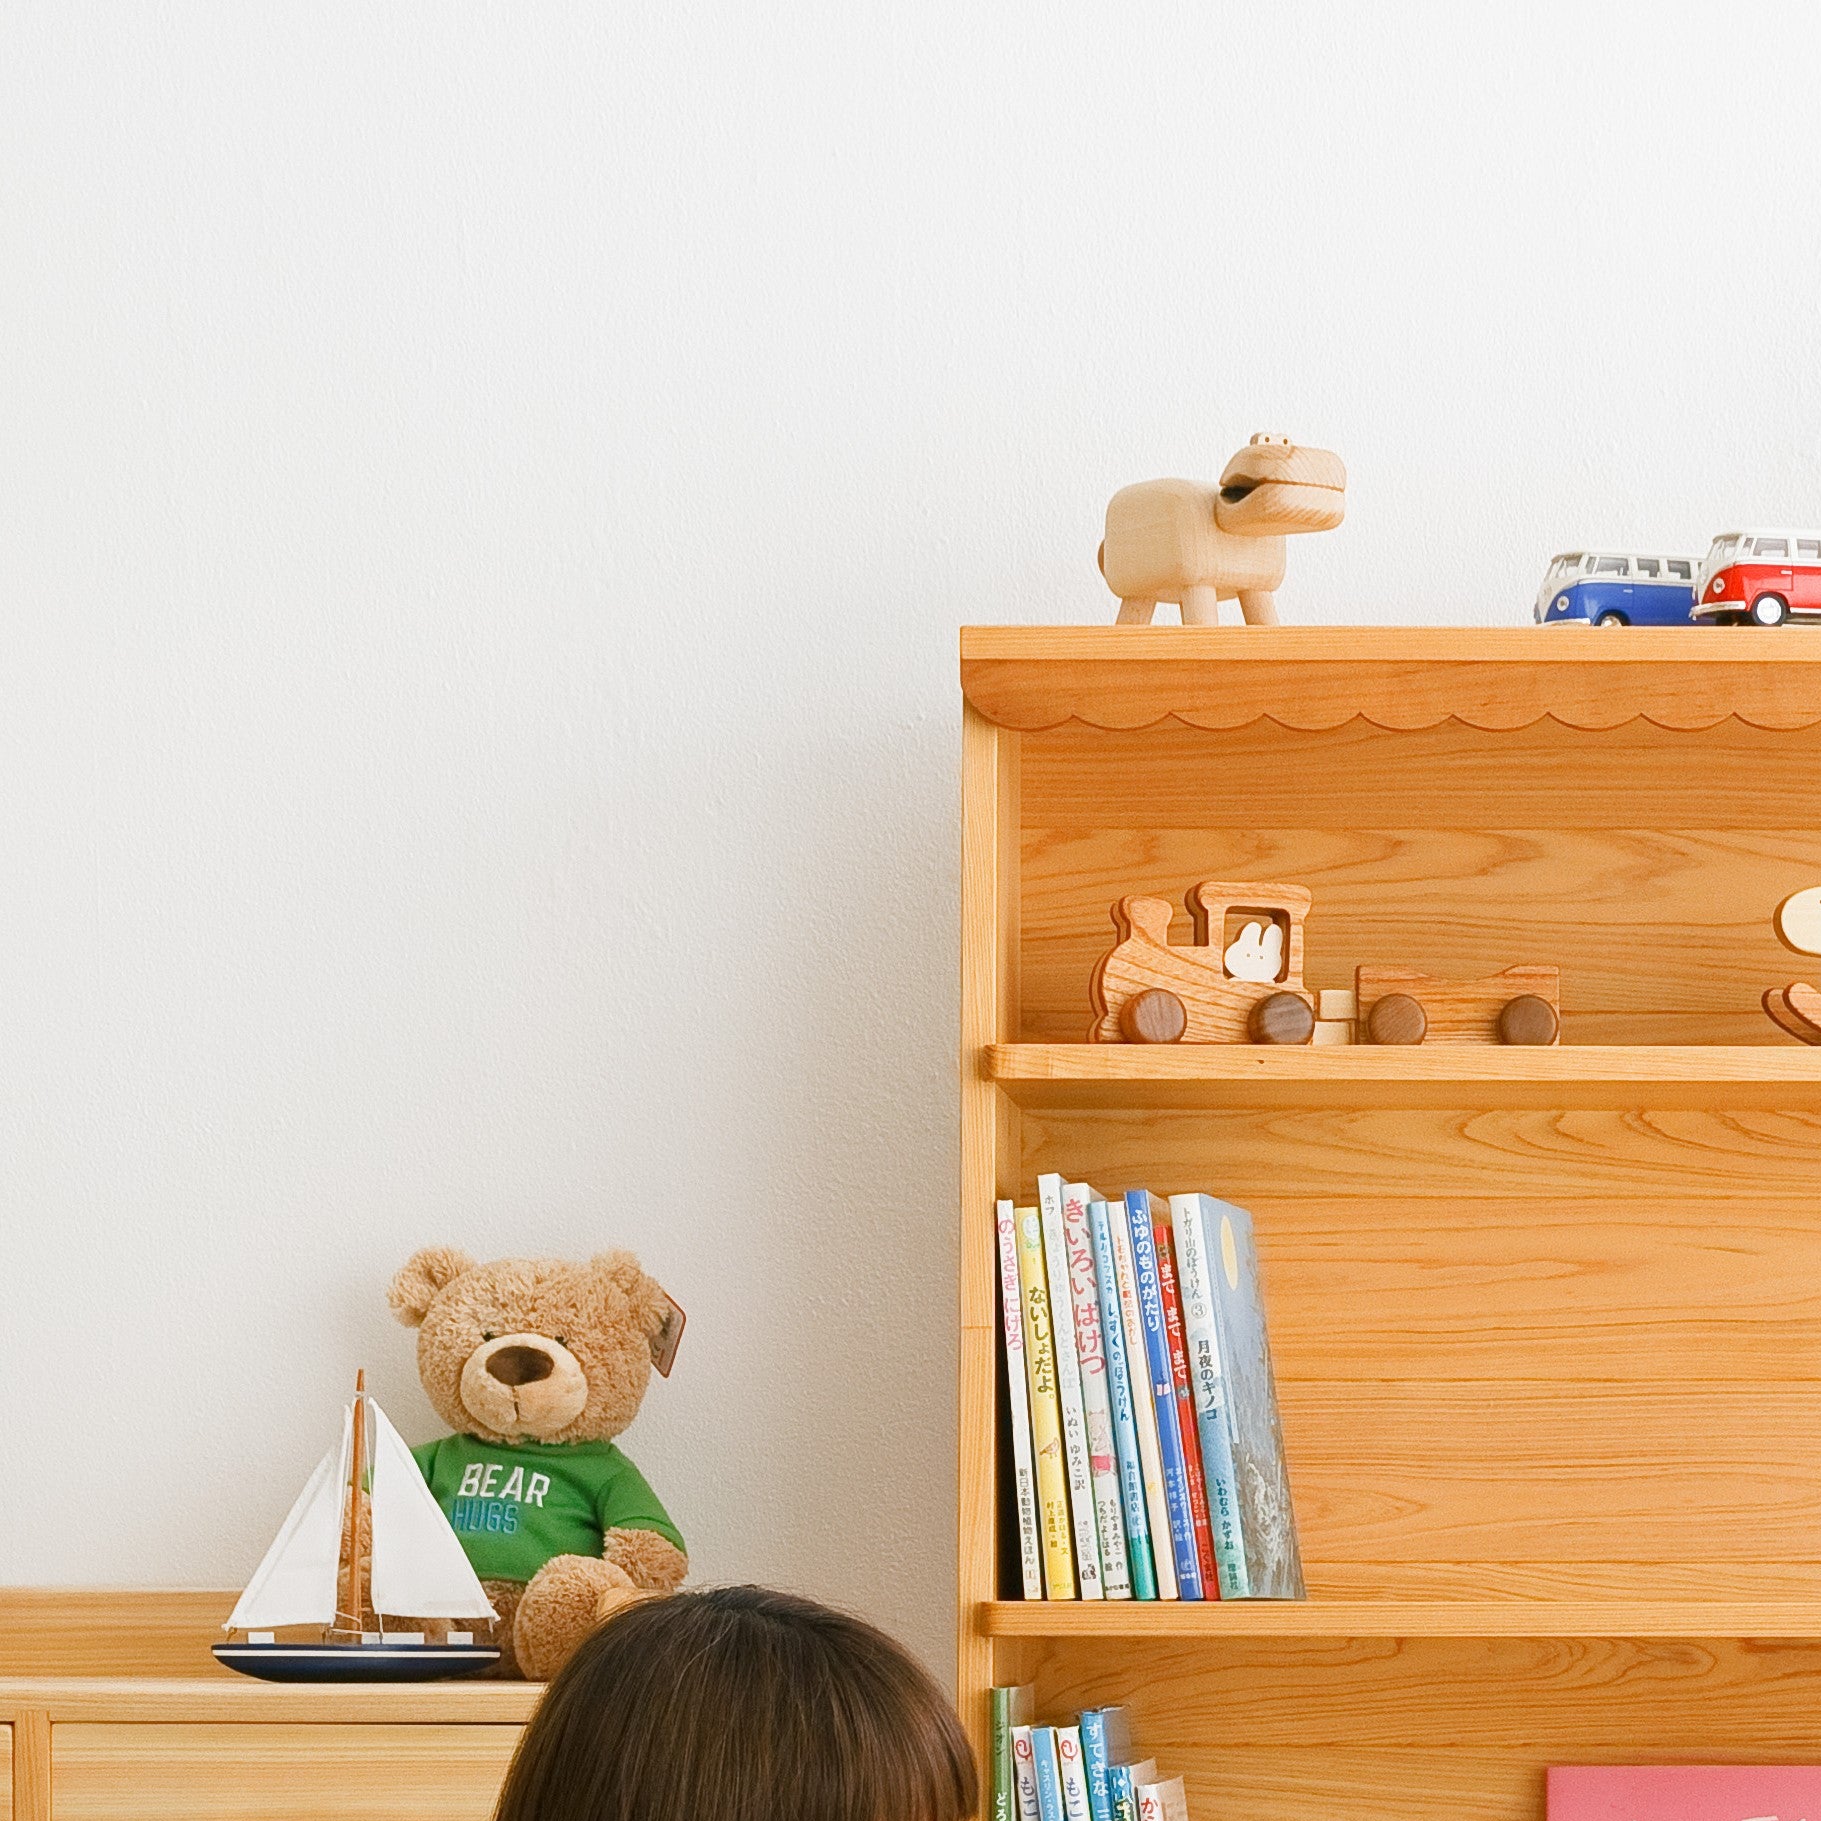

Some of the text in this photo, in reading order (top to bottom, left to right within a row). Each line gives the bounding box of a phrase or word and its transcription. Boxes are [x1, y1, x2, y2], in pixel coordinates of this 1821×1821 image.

[1065, 1198, 1106, 1375] きいろい ばけつ
[1131, 1209, 1161, 1332] ふゆのものがたり
[456, 1462, 551, 1508] BEAR
[451, 1499, 520, 1535] HUGS
[1086, 1723, 1109, 1797] すてきな
[1020, 1776, 1040, 1817] もこ
[1066, 1777, 1084, 1818] もこ
